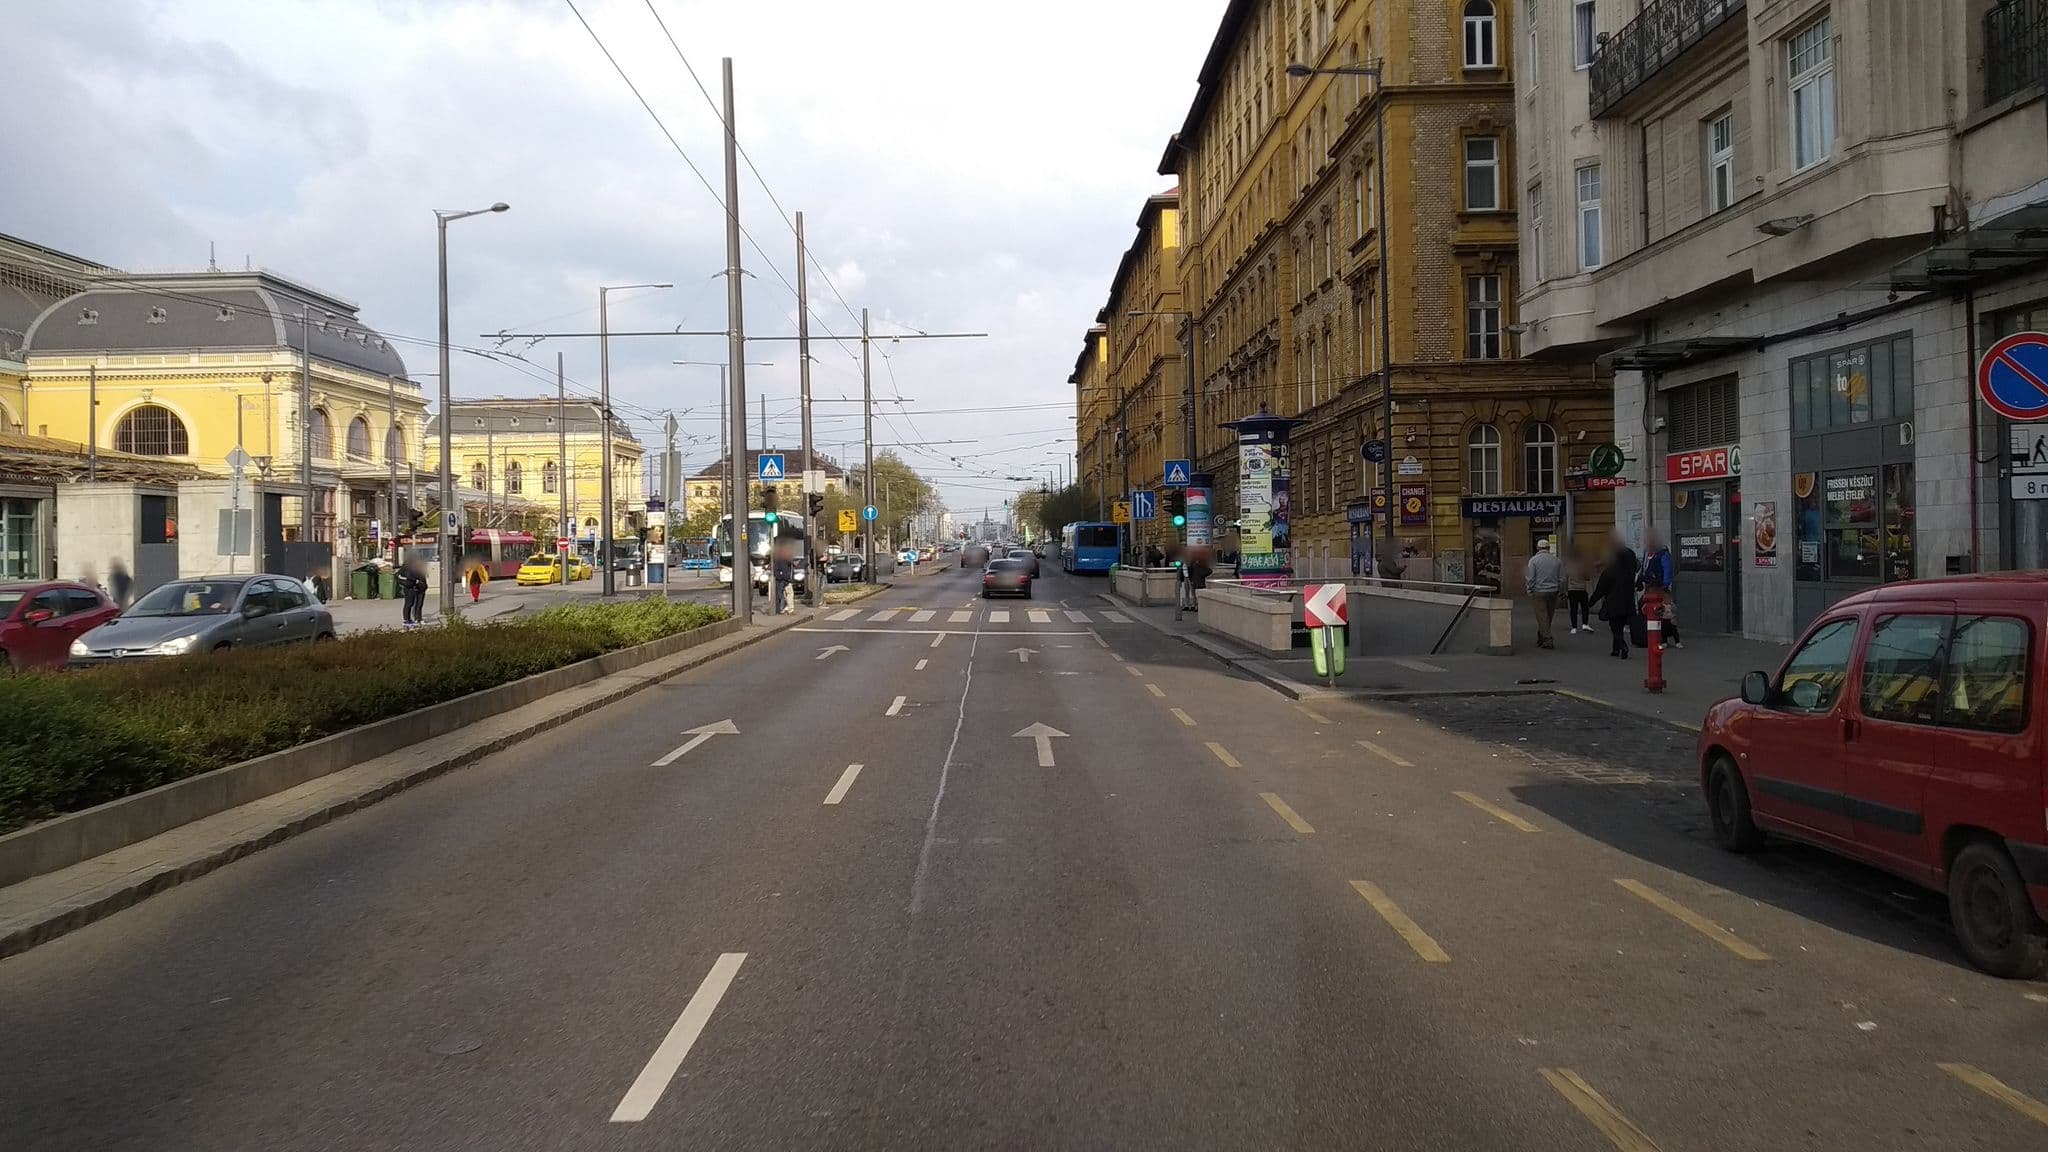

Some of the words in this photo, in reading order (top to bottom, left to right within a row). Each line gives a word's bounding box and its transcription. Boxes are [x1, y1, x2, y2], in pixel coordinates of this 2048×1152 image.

[1836, 357, 1858, 369] SPAR
[1836, 373, 1848, 392] to
[1680, 452, 1726, 476] SPAR
[1592, 478, 1625, 487] SPAR
[2027, 481, 2036, 495] 8
[1401, 487, 1425, 497] CHANGE
